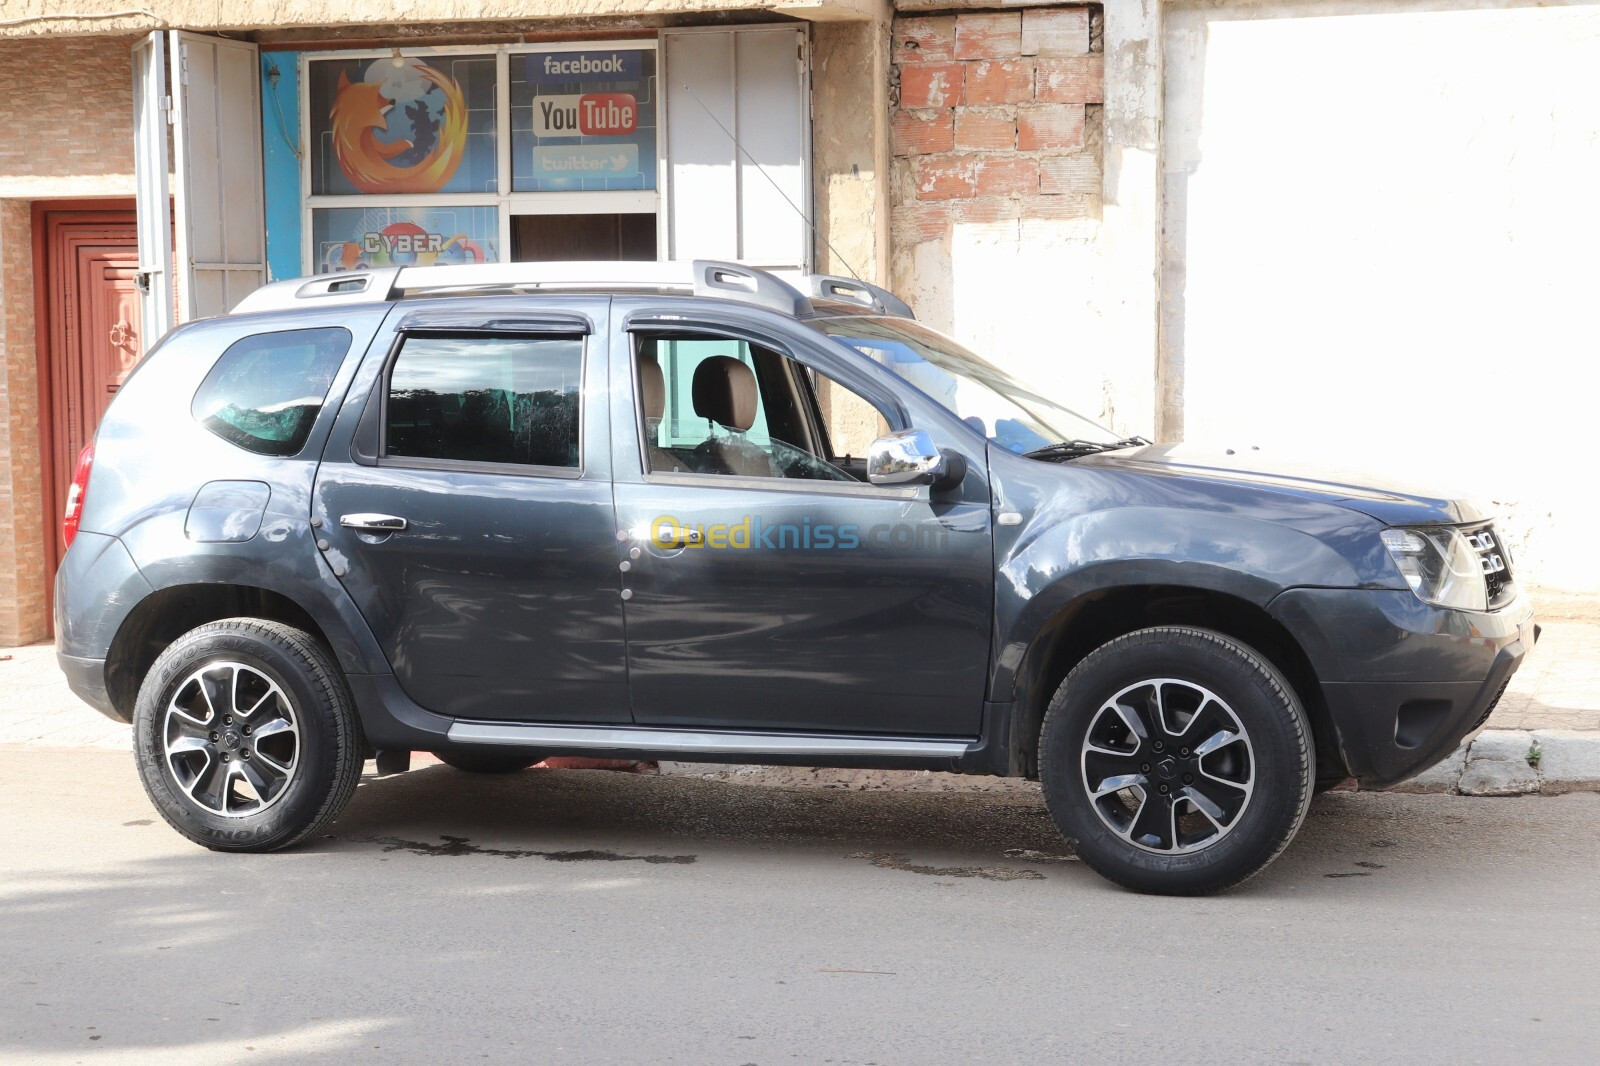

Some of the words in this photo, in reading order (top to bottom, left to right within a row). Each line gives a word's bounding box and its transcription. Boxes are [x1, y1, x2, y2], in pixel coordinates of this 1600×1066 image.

[543, 54, 624, 75] facebook
[540, 99, 633, 130] YouTube
[541, 155, 609, 172] twitter
[363, 232, 444, 254] CYBER
